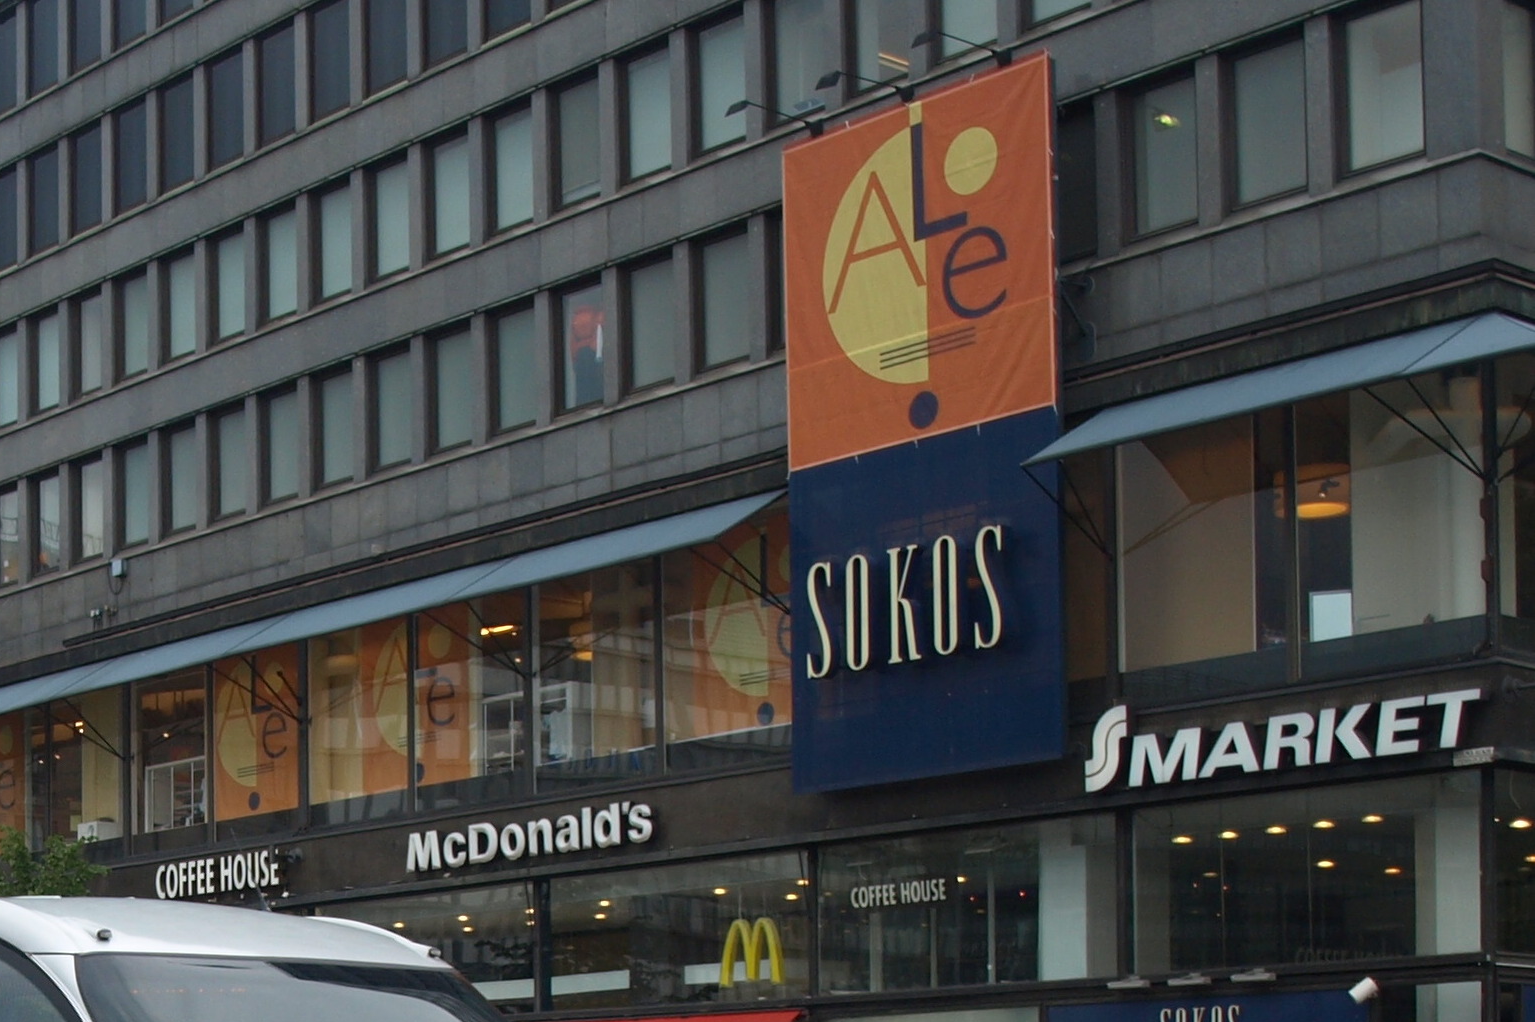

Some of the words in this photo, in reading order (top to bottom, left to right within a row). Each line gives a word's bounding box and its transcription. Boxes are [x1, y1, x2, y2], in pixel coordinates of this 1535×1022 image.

[806, 525, 1002, 679] SOKOS
[406, 801, 652, 873] McDonald's
[156, 858, 215, 900] COFFEE
[220, 848, 280, 892] HOUSE
[851, 886, 897, 909] COFFEE
[900, 878, 946, 904] HOUSE
